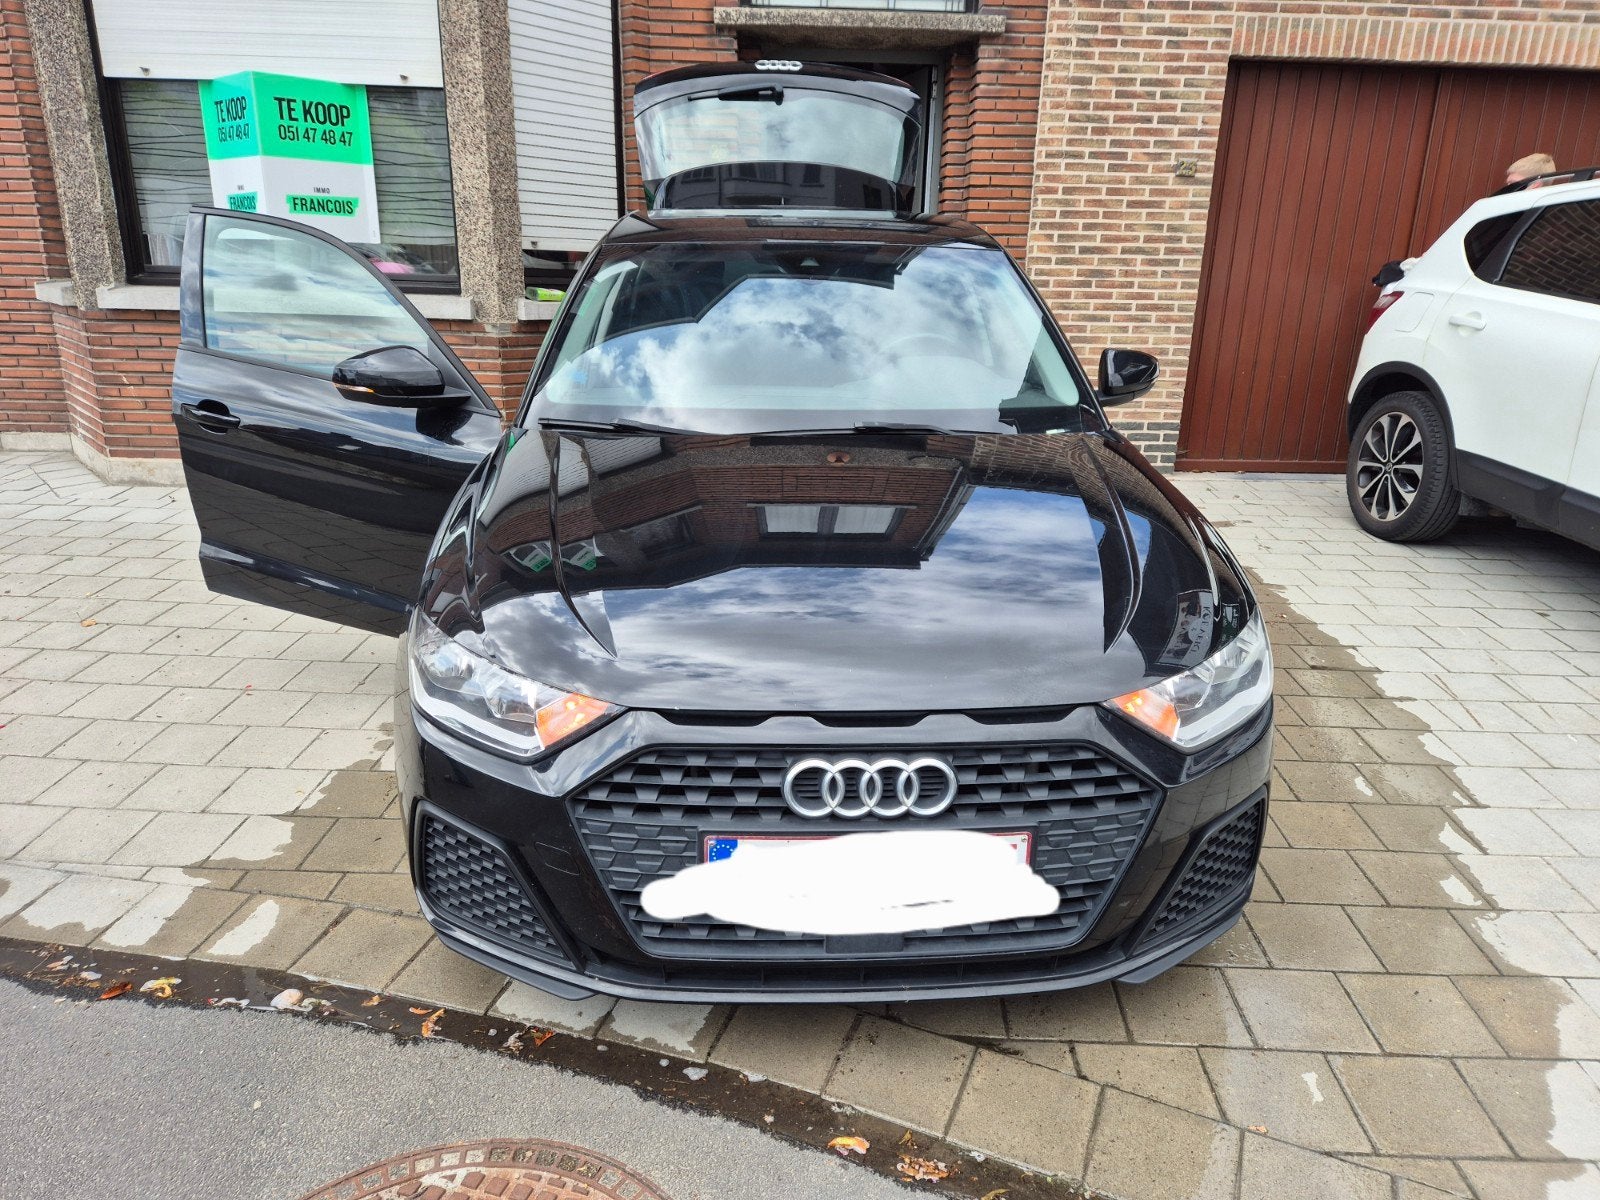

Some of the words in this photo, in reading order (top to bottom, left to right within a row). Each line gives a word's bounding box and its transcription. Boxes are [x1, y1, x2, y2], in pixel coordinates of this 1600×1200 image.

[214, 100, 226, 123] TE
[226, 96, 247, 122] KOOP
[273, 96, 299, 122] TE
[302, 99, 351, 127] KOOP
[218, 126, 228, 142] 051
[278, 124, 300, 142] 051
[303, 127, 317, 143] 47
[321, 129, 336, 145] 48
[339, 131, 353, 147] 47
[313, 186, 331, 194] IMMO
[229, 195, 257, 211] FRANCOIS
[292, 196, 354, 215] FRANCOIS
